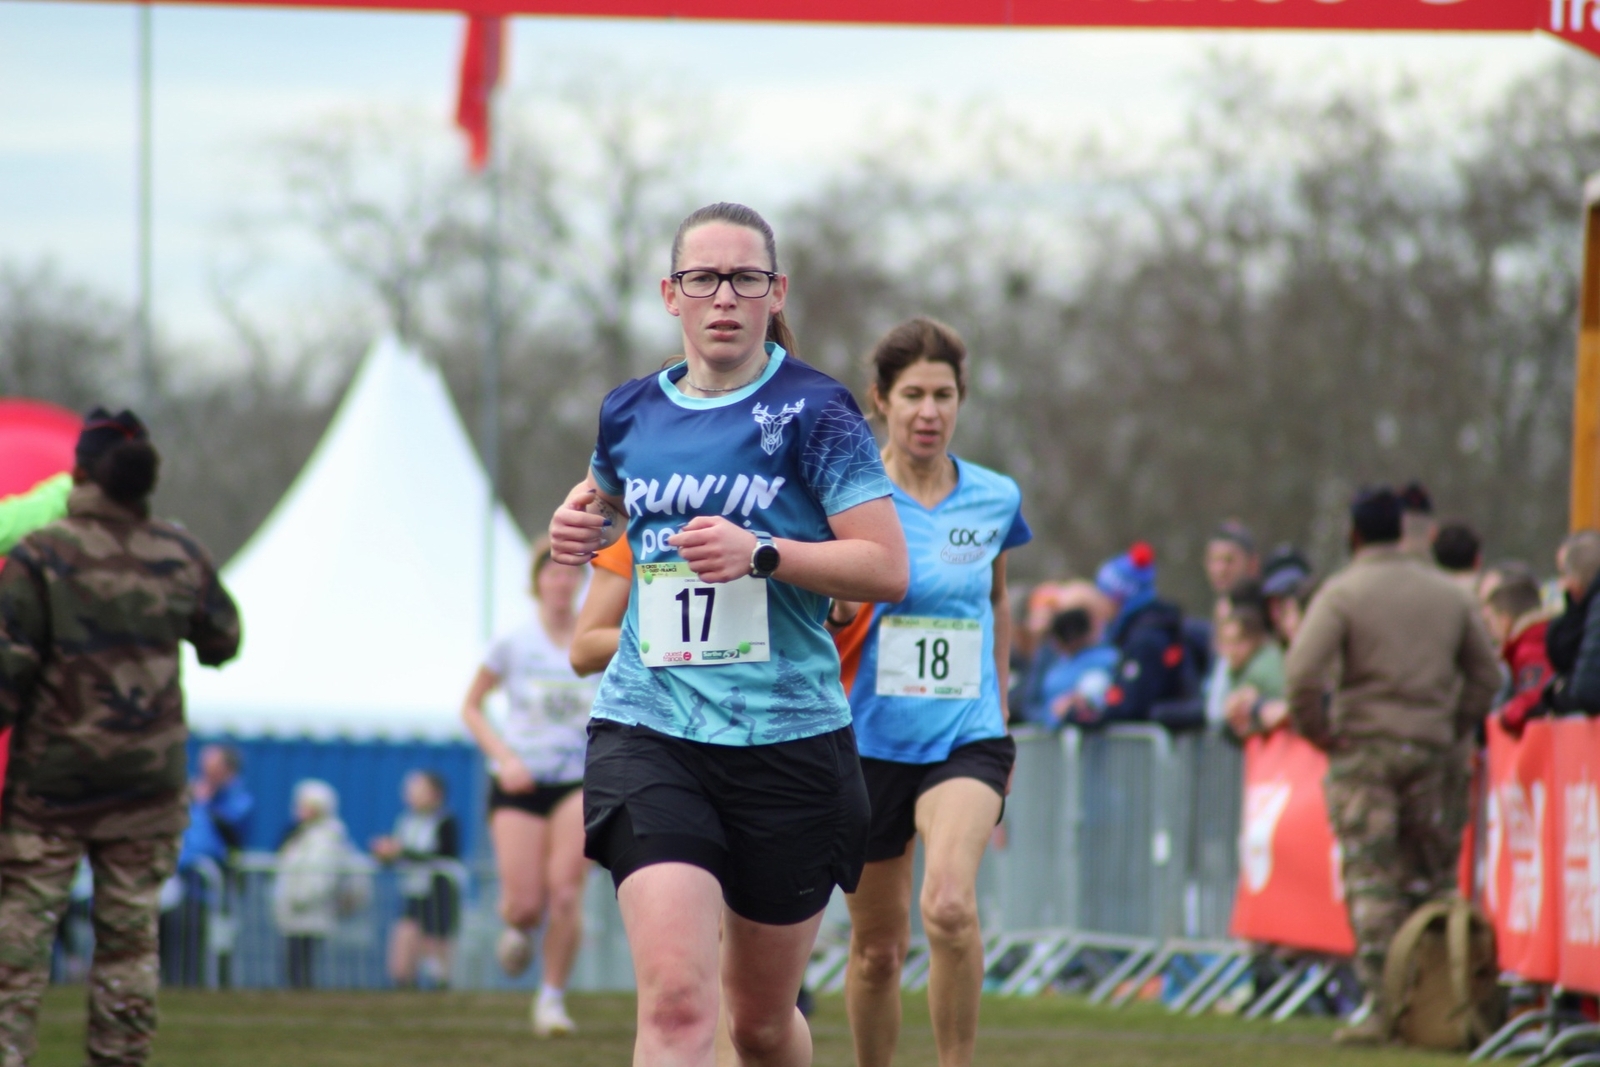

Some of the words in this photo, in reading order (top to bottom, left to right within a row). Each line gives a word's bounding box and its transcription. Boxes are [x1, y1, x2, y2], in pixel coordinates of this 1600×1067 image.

[949, 528, 982, 546] COC
[675, 587, 715, 642] 17
[915, 638, 949, 680] 18
